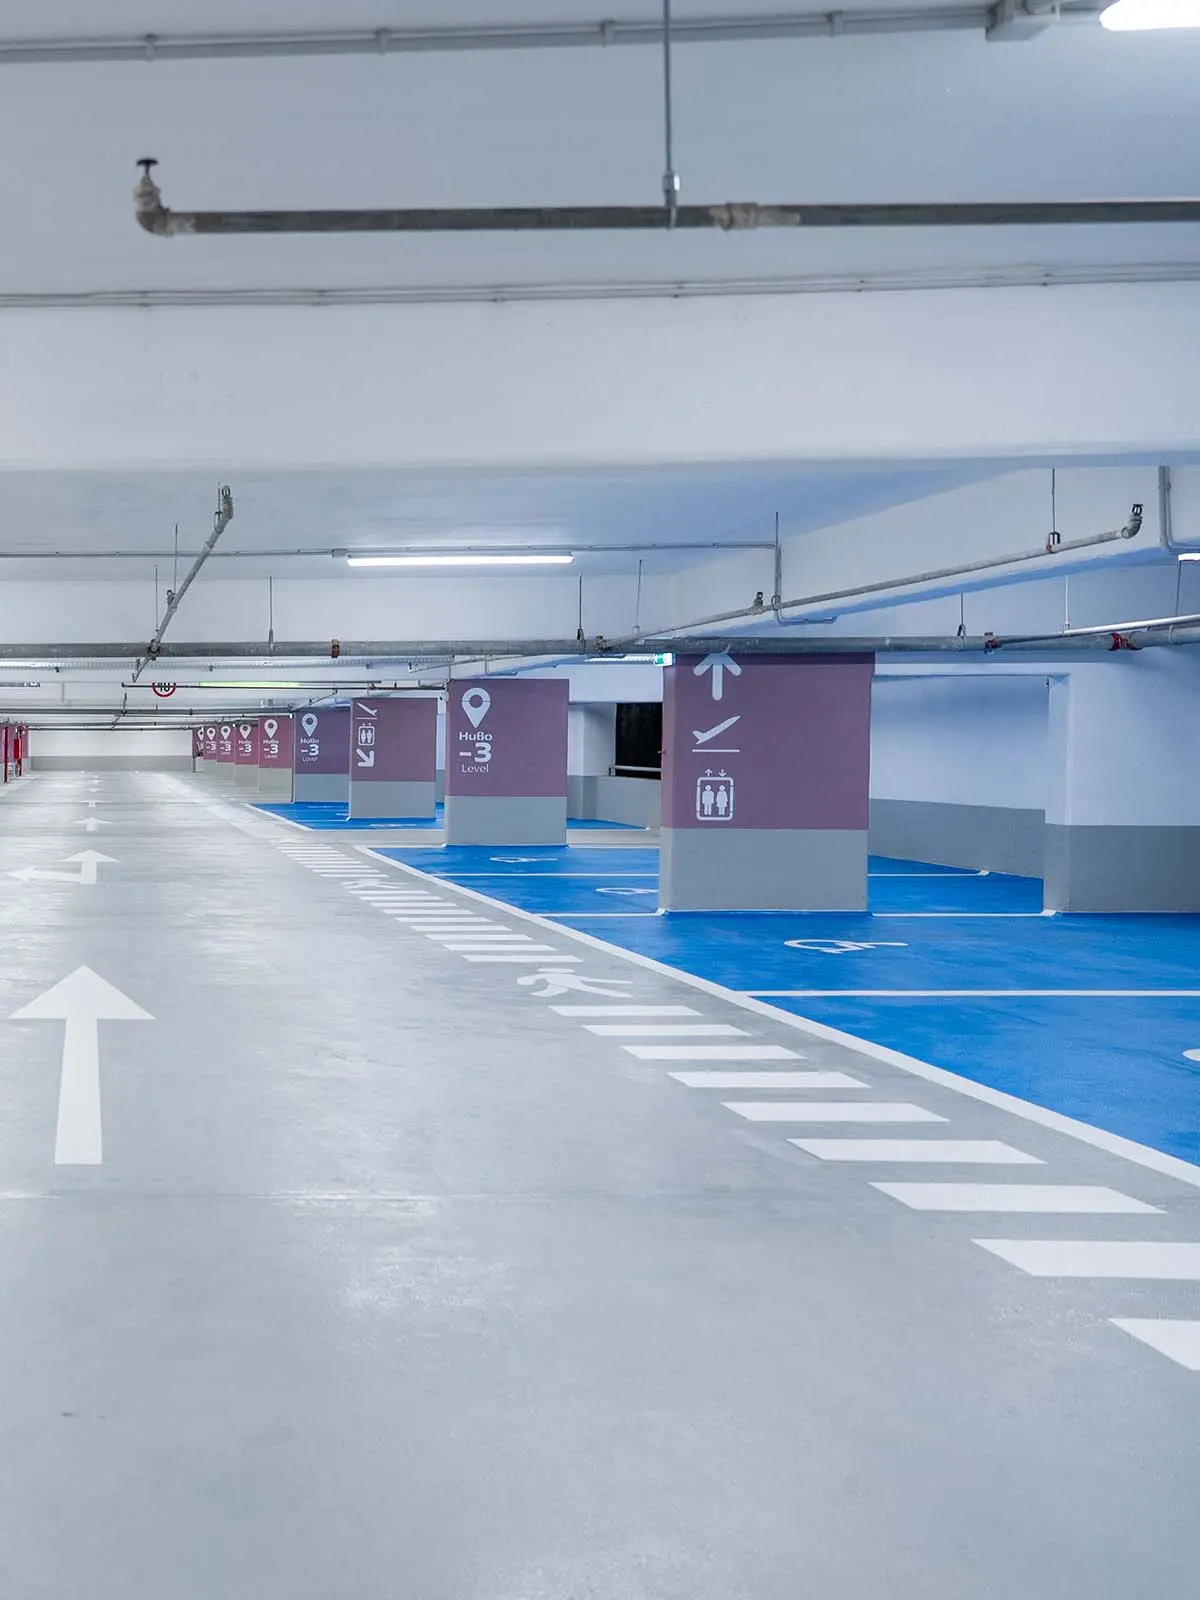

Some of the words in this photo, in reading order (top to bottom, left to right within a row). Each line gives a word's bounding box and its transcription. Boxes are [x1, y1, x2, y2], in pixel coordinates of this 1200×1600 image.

[239, 744, 252, 753] -3
[263, 744, 279, 754] -3
[300, 744, 320, 756] -3
[459, 742, 493, 763] -3
[461, 764, 489, 773] Level
